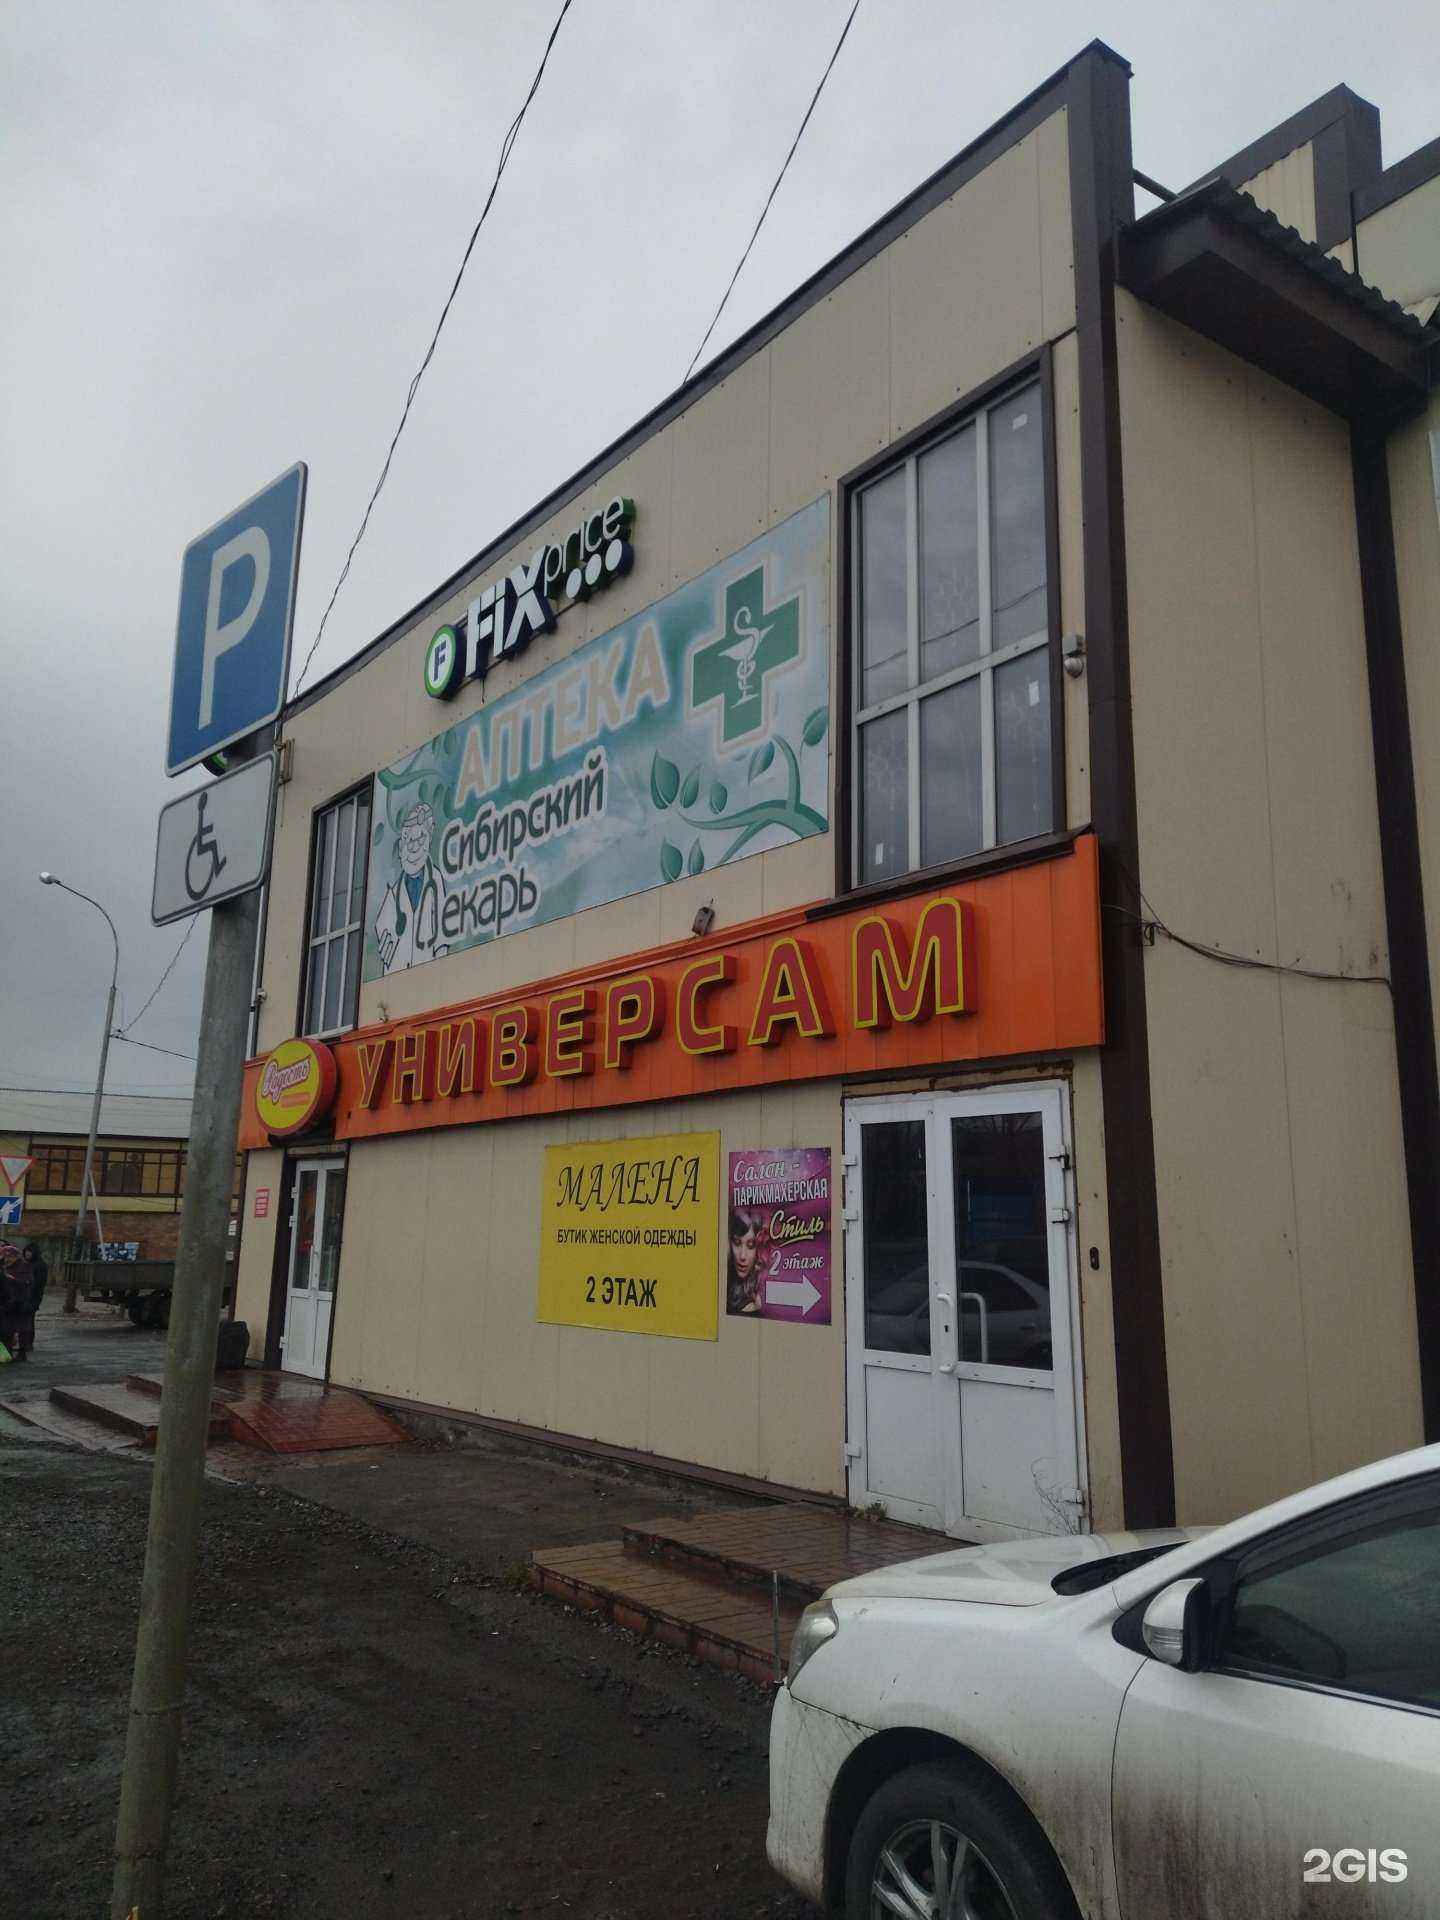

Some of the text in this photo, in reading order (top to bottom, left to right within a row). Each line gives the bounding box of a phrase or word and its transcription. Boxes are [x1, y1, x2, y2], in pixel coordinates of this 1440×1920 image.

[465, 545, 547, 678] FIX
[544, 496, 625, 597] price
[198, 526, 271, 730] P
[454, 618, 672, 806] АПТЕКА
[442, 757, 605, 872] Сибирский
[414, 867, 538, 950] Лекарь
[356, 897, 970, 1109] УНИВЕРСАМ
[556, 1155, 701, 1212] МАЛЕНА
[733, 1160, 785, 1183] Салон
[733, 1178, 828, 1206] ПАРИКМАХЕРСКАЯ
[557, 1226, 697, 1248] БУТИК ЖЕНСКОЙ ОДЕЖДЫ
[769, 1209, 824, 1240] Стиль
[768, 1250, 824, 1276] 2 этаж
[585, 1276, 658, 1308] 2 ЭТАЖ
